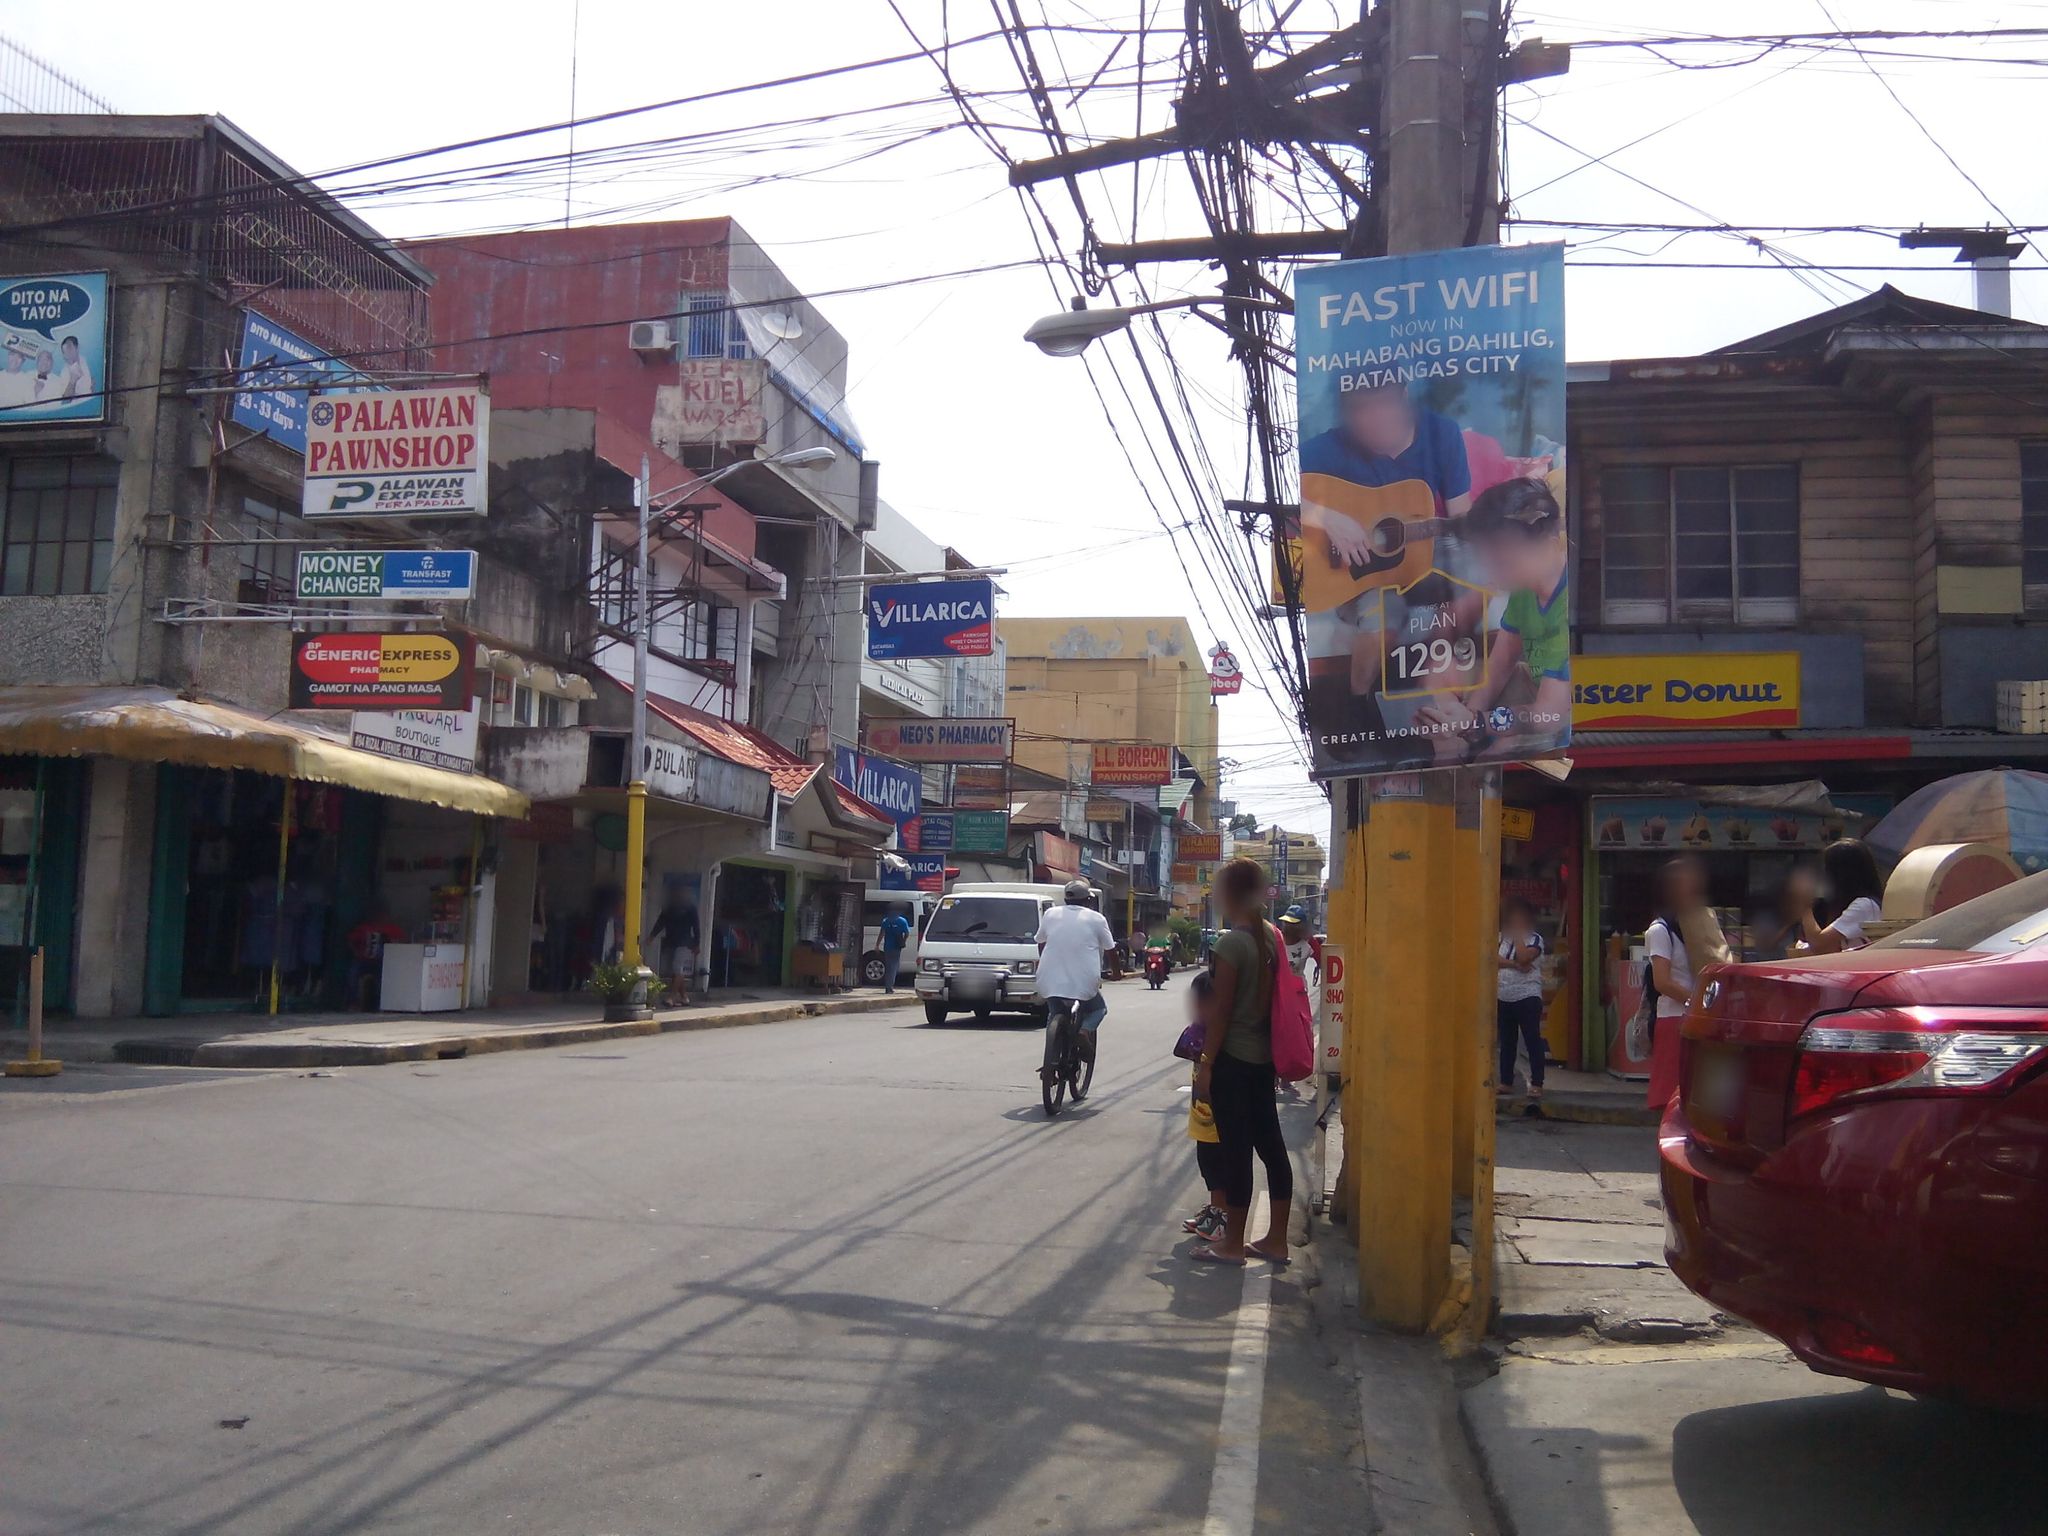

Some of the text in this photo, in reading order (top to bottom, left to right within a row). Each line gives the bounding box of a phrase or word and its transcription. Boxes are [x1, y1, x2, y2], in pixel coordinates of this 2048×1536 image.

[11, 289, 70, 305] DITO NA
[1319, 270, 1538, 328] FAST WIFI
[21, 304, 61, 320] TAYO!
[250, 322, 269, 340] DITO
[270, 335, 282, 349] NA
[1390, 316, 1464, 339] NOW IN
[1308, 328, 1555, 373] MAHABANG DAHILIG,
[1340, 354, 1521, 393] BATANGAS CITY
[272, 407, 294, 430] days
[333, 394, 476, 433] PALAWAN
[310, 434, 475, 472] PAWNSHOP
[378, 489, 464, 501] EXPRESS
[302, 556, 382, 574] MONEY
[402, 570, 452, 578] TRANSFAST
[301, 576, 381, 594] CHANGER
[872, 599, 988, 628] VILLARICA
[1410, 612, 1457, 634] PLAN
[305, 650, 452, 661] GENERIC EXPRESS
[1390, 637, 1476, 679] 1299
[350, 666, 410, 674] PHARMACY
[309, 683, 442, 693] GAMOT NA PANG MASA
[1571, 680, 1782, 704] ister Donut
[1519, 711, 1561, 724] Globe
[396, 726, 441, 747] BOUTIQUE
[900, 725, 1005, 745] NEO'S PHARMACY
[1320, 719, 1485, 745] CREATE. WONDERFUL.
[1117, 745, 1168, 768] BORBON
[849, 752, 916, 814] VILLARICA
[1097, 773, 1166, 782] PAWNSHOP
